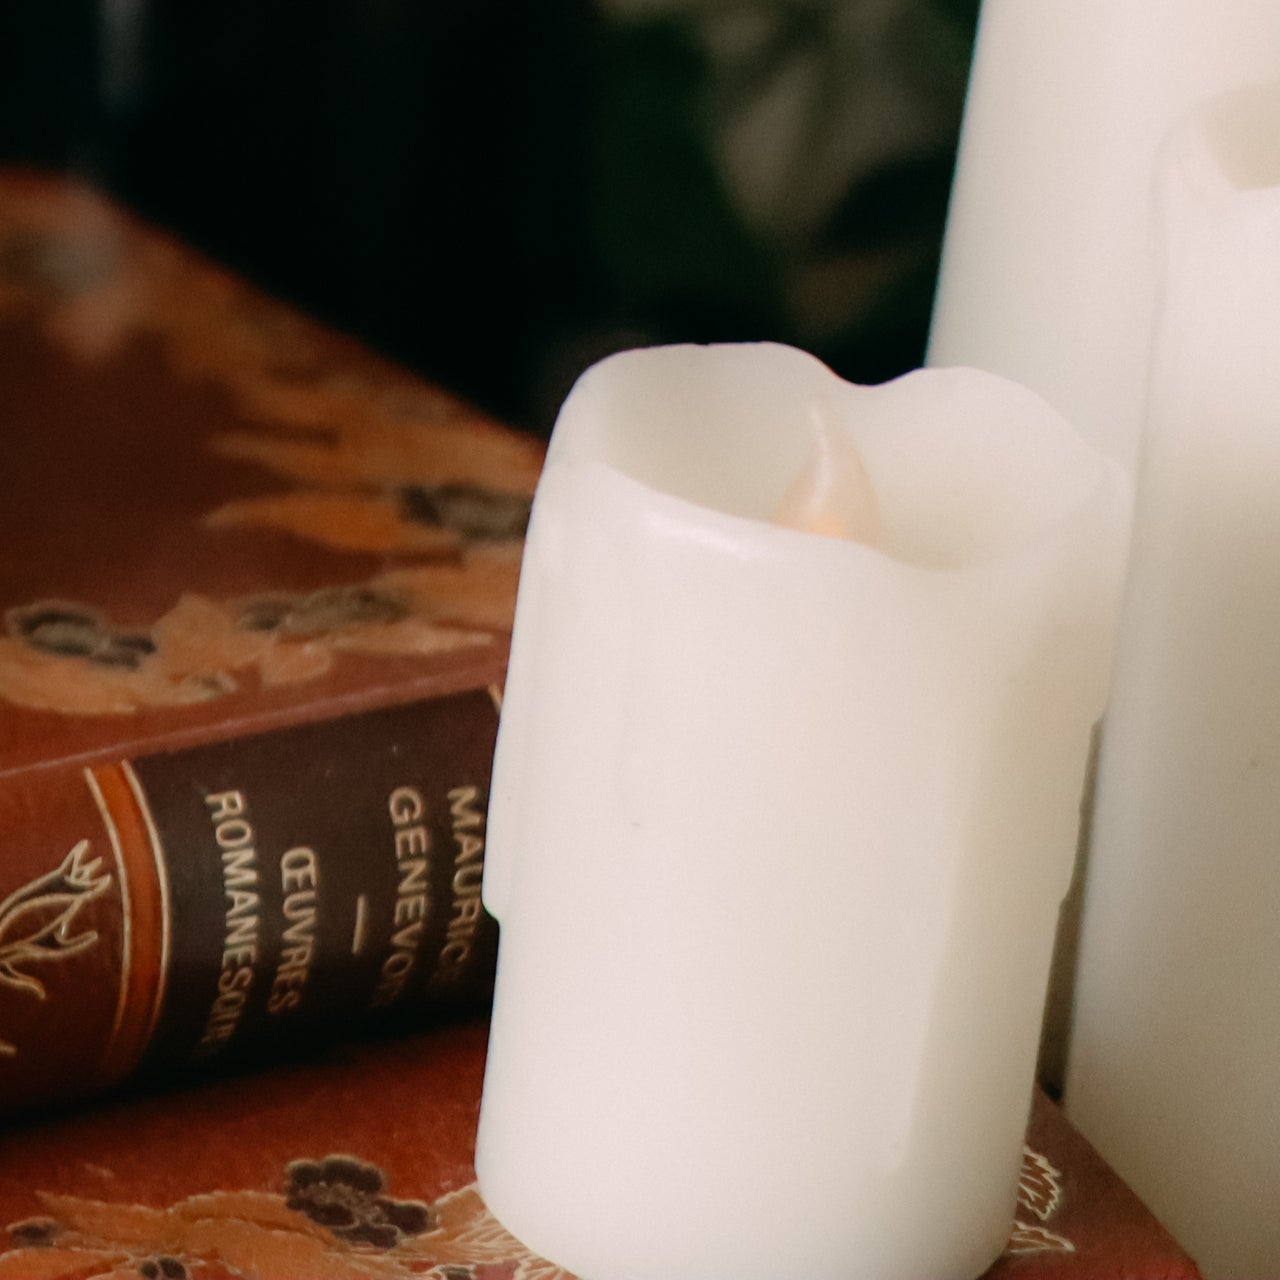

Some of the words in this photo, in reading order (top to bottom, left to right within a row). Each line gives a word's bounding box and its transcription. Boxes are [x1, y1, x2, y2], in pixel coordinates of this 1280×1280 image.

[193, 789, 261, 1056] ROMANESQU
[266, 846, 321, 1015] ŒUVRES
[368, 786, 425, 1009] GENEVO
